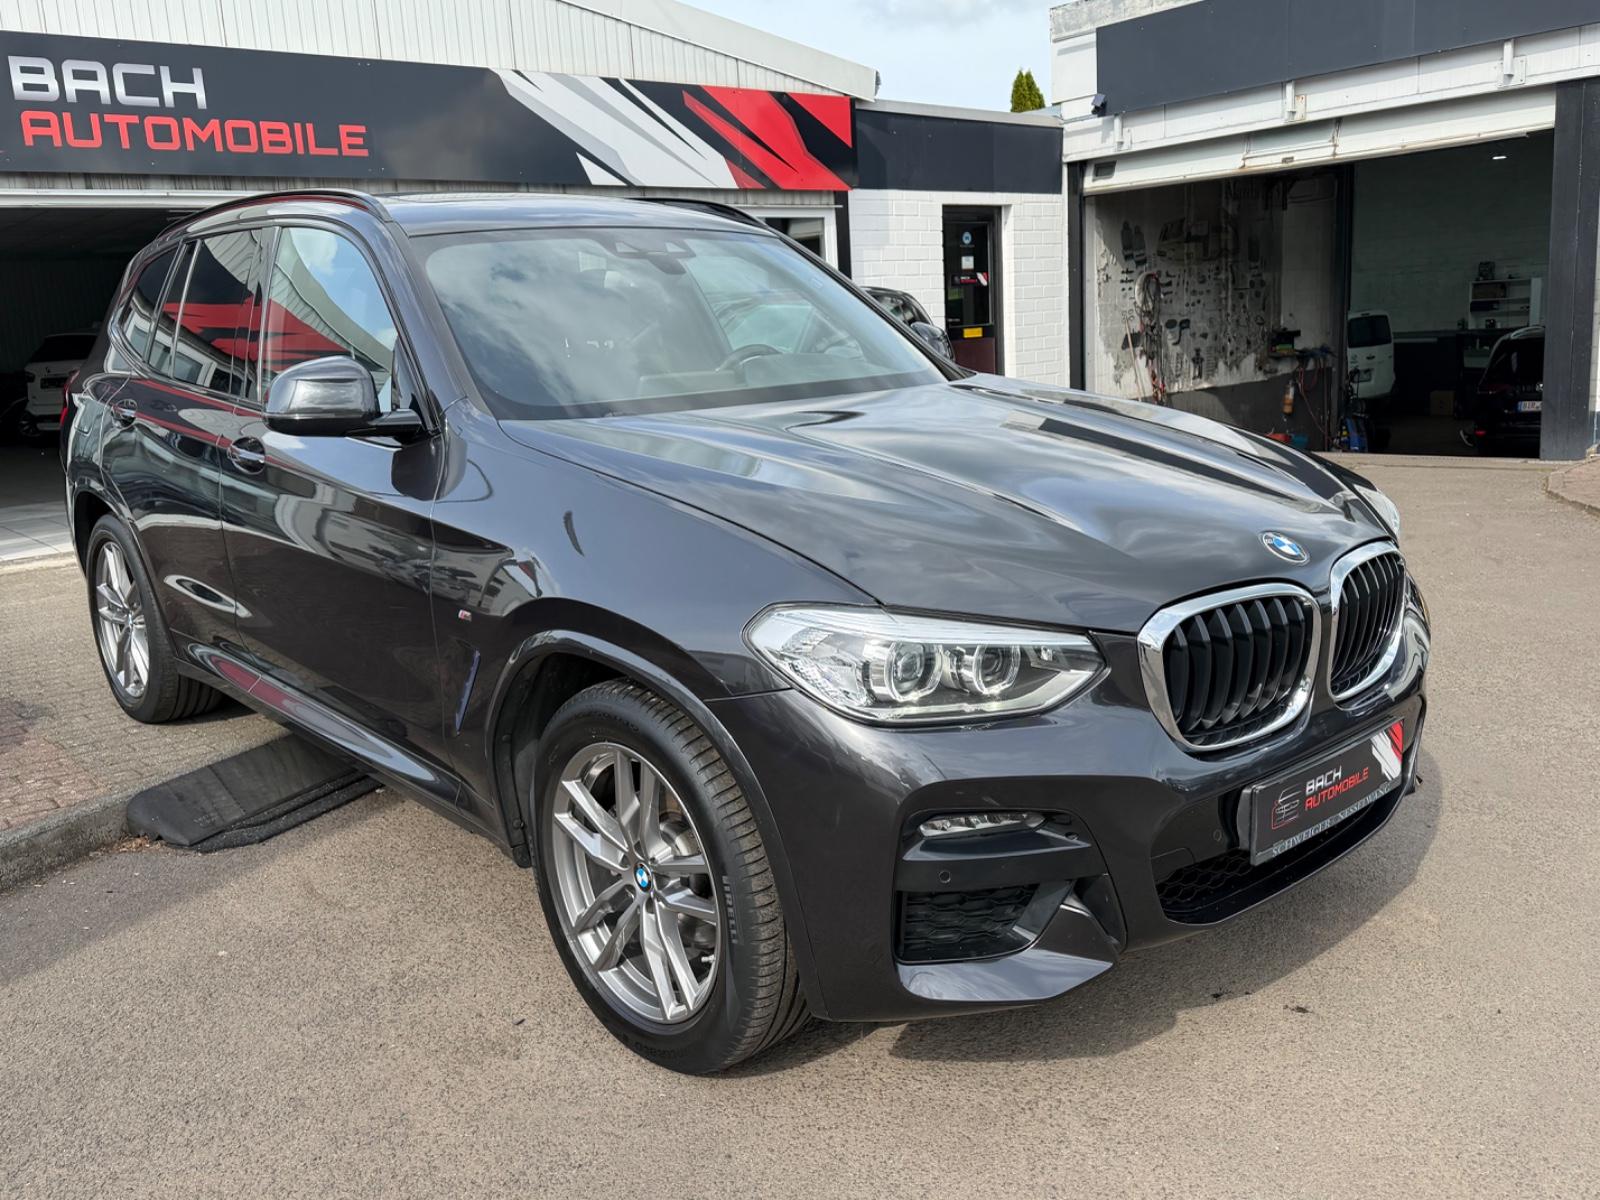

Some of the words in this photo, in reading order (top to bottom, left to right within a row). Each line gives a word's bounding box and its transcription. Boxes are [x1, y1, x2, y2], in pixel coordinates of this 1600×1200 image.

[8, 55, 207, 110] BACH
[20, 110, 369, 157] AUTOMOBILE
[1305, 765, 1342, 795] BACH
[1305, 767, 1369, 810] AUTOMOBILE
